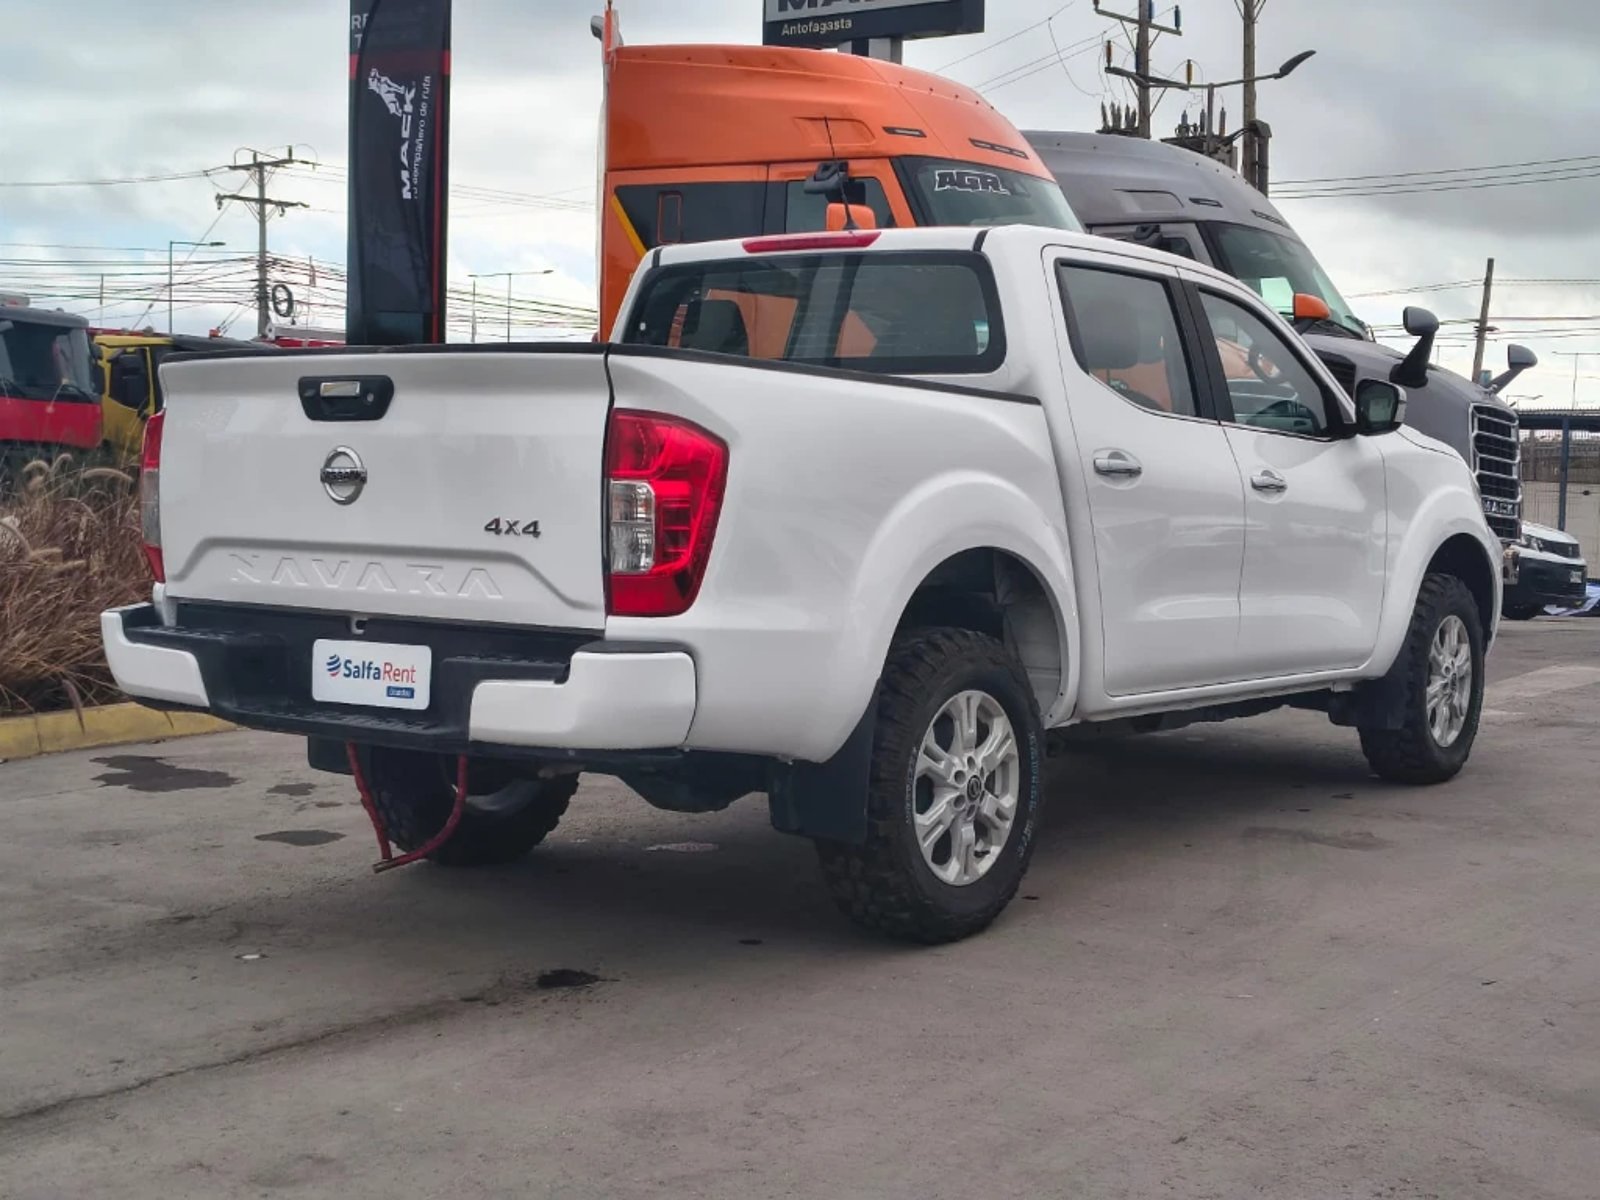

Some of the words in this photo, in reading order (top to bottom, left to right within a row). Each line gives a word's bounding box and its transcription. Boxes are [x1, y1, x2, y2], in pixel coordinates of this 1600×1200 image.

[781, 18, 853, 36] Antofagasta
[422, 75, 432, 100] ruta
[420, 102, 428, 117] de
[401, 87, 416, 200] MACK
[229, 553, 503, 599] NAVARA
[343, 659, 416, 683] SalfaRent
